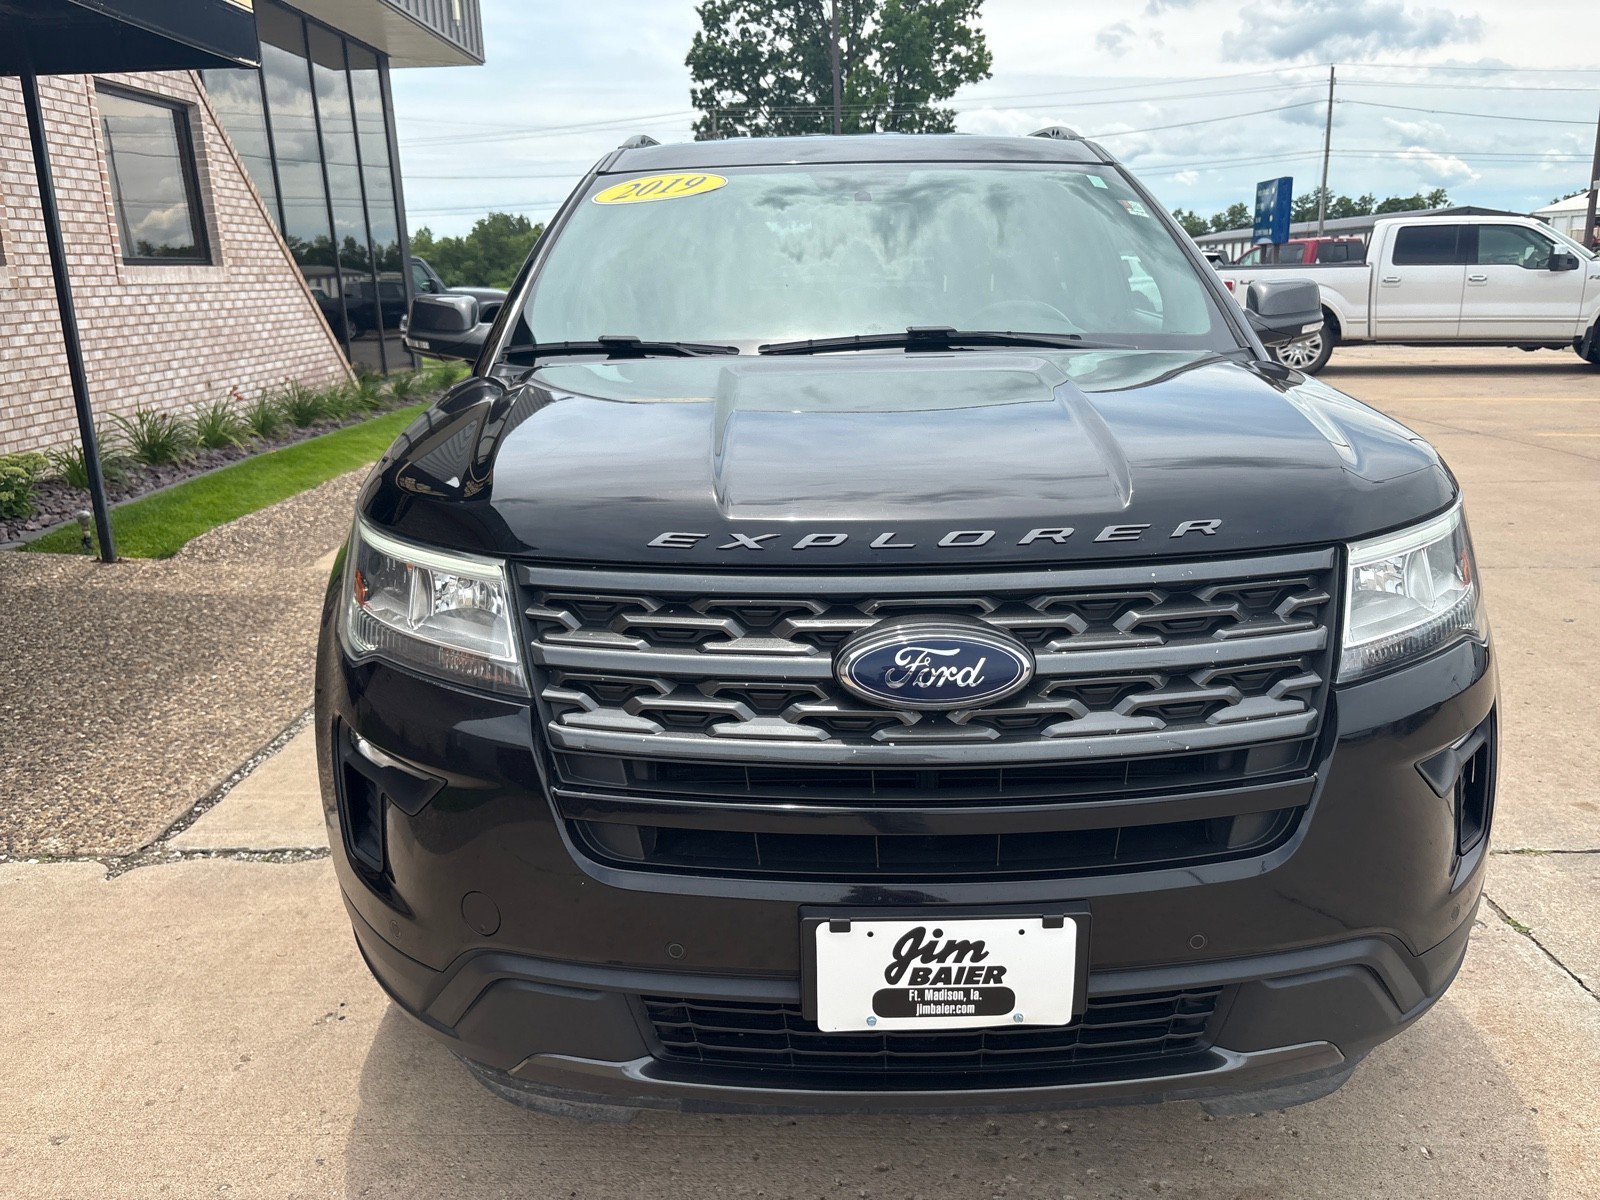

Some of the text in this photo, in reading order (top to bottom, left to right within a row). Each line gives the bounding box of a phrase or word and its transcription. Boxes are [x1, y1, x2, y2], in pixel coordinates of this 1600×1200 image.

[609, 176, 708, 202] 2019
[646, 517, 1223, 551] EXPLORER
[884, 646, 987, 690] Ford
[884, 926, 989, 985] Jim
[907, 965, 1007, 986] BAIER
[908, 989, 922, 1002] Ft.
[924, 988, 967, 1002] Madison,
[915, 1003, 976, 1017] jimbaier.com
